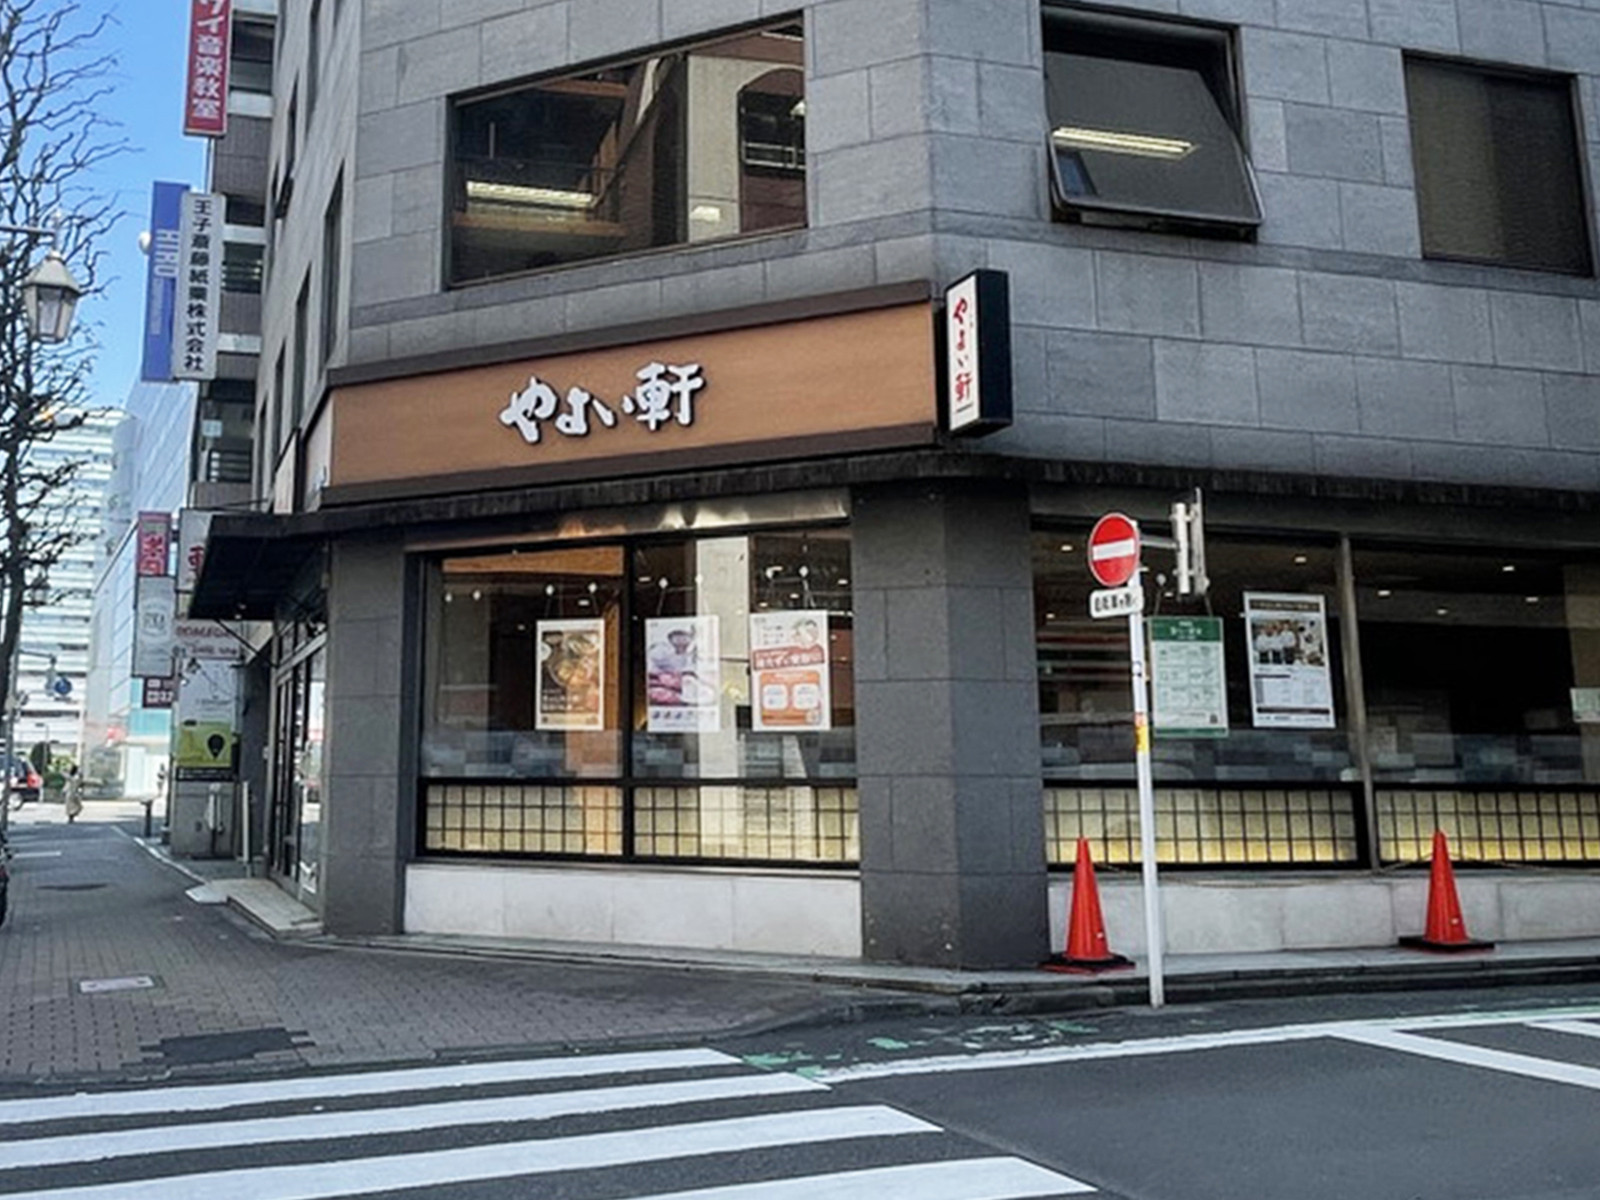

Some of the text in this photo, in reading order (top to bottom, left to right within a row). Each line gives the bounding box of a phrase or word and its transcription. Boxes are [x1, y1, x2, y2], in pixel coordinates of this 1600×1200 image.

[953, 298, 972, 401] やよい軒
[499, 361, 704, 444] やよい軒
